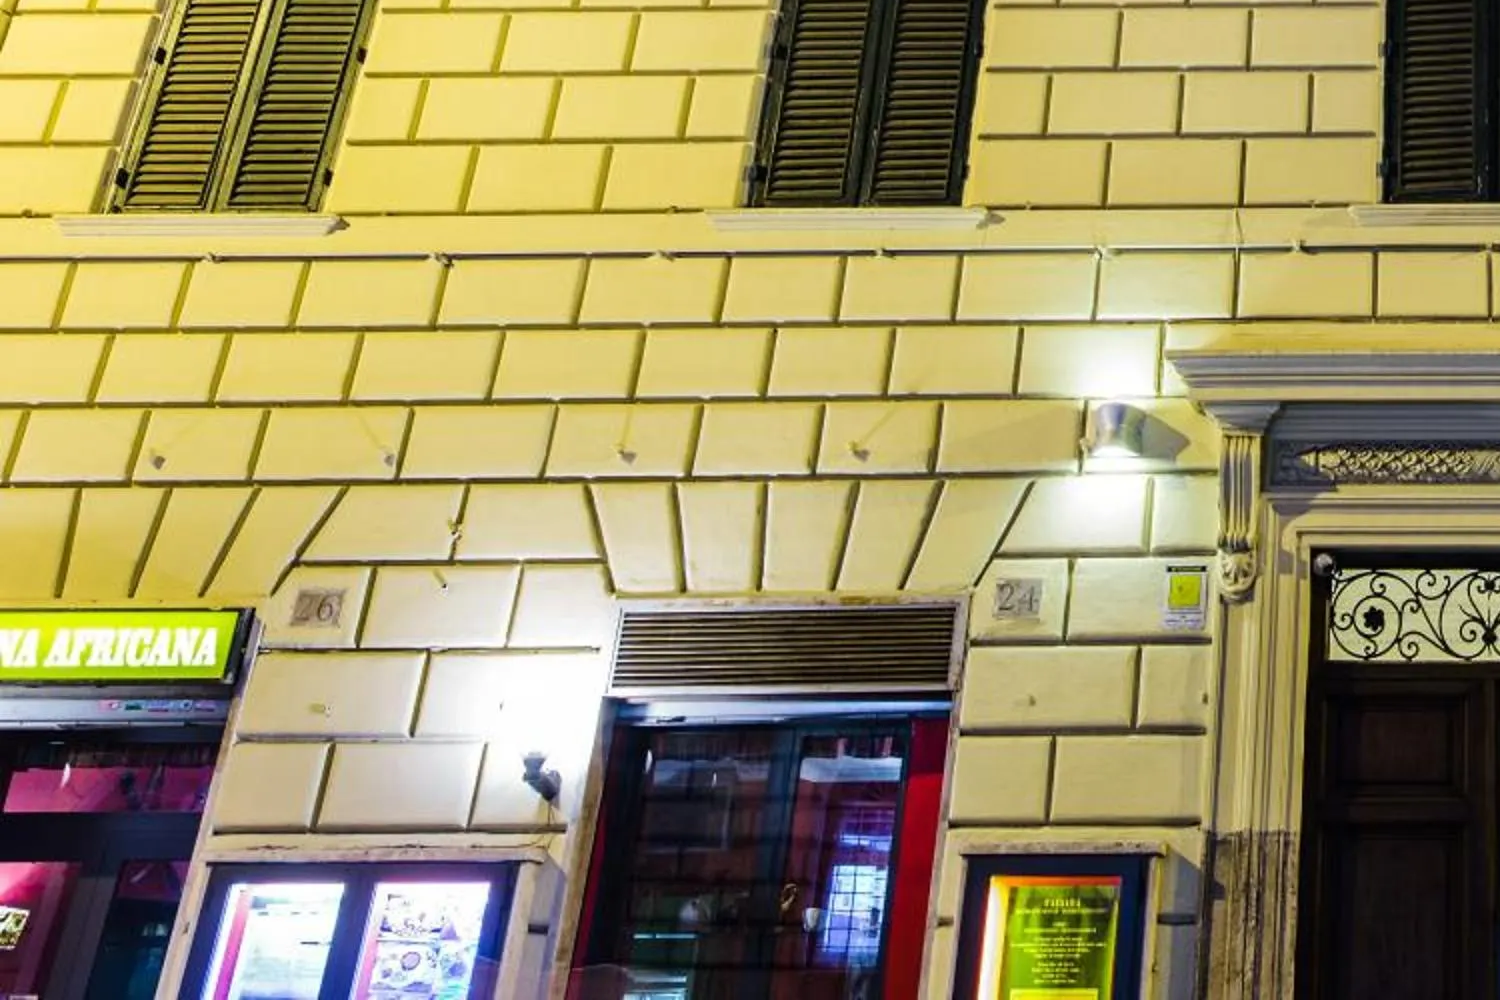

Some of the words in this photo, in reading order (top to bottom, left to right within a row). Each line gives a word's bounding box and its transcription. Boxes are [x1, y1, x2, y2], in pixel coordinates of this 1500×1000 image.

[296, 593, 340, 621] 26
[997, 583, 1039, 611] 24
[43, 628, 218, 667] AFRICANA
